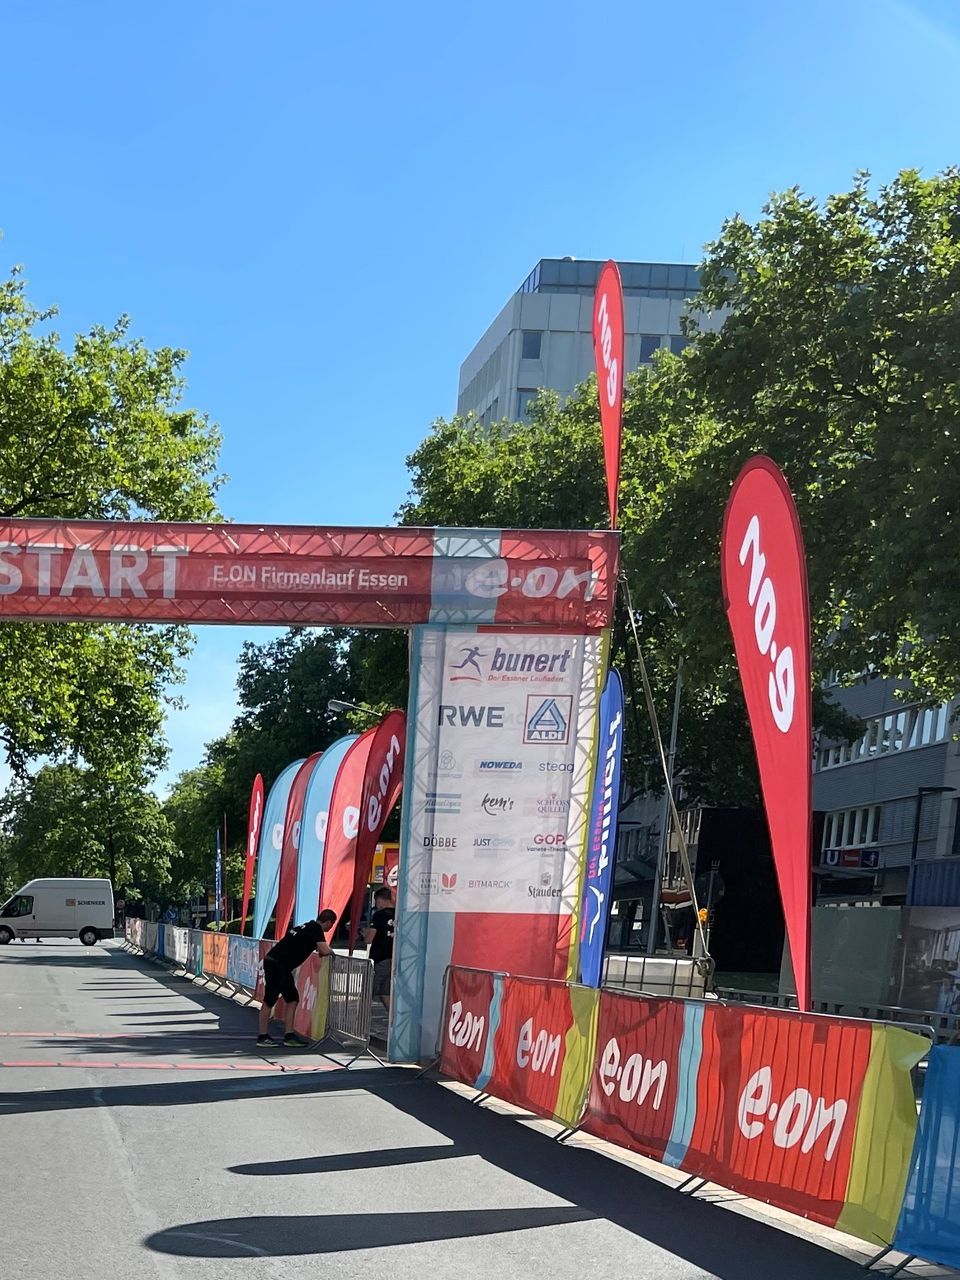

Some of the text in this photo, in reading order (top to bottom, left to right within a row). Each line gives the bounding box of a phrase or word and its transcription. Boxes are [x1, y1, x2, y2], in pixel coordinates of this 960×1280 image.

[213, 565, 408, 587] E.ON Firmenlauf Essen
[490, 647, 572, 673] bunert
[438, 705, 505, 728] RWE
[530, 730, 562, 741] ALDI
[479, 760, 523, 770] NOWEDA
[538, 761, 575, 774] steag
[423, 833, 457, 848] DÖBBE
[472, 838, 491, 846] JUST
